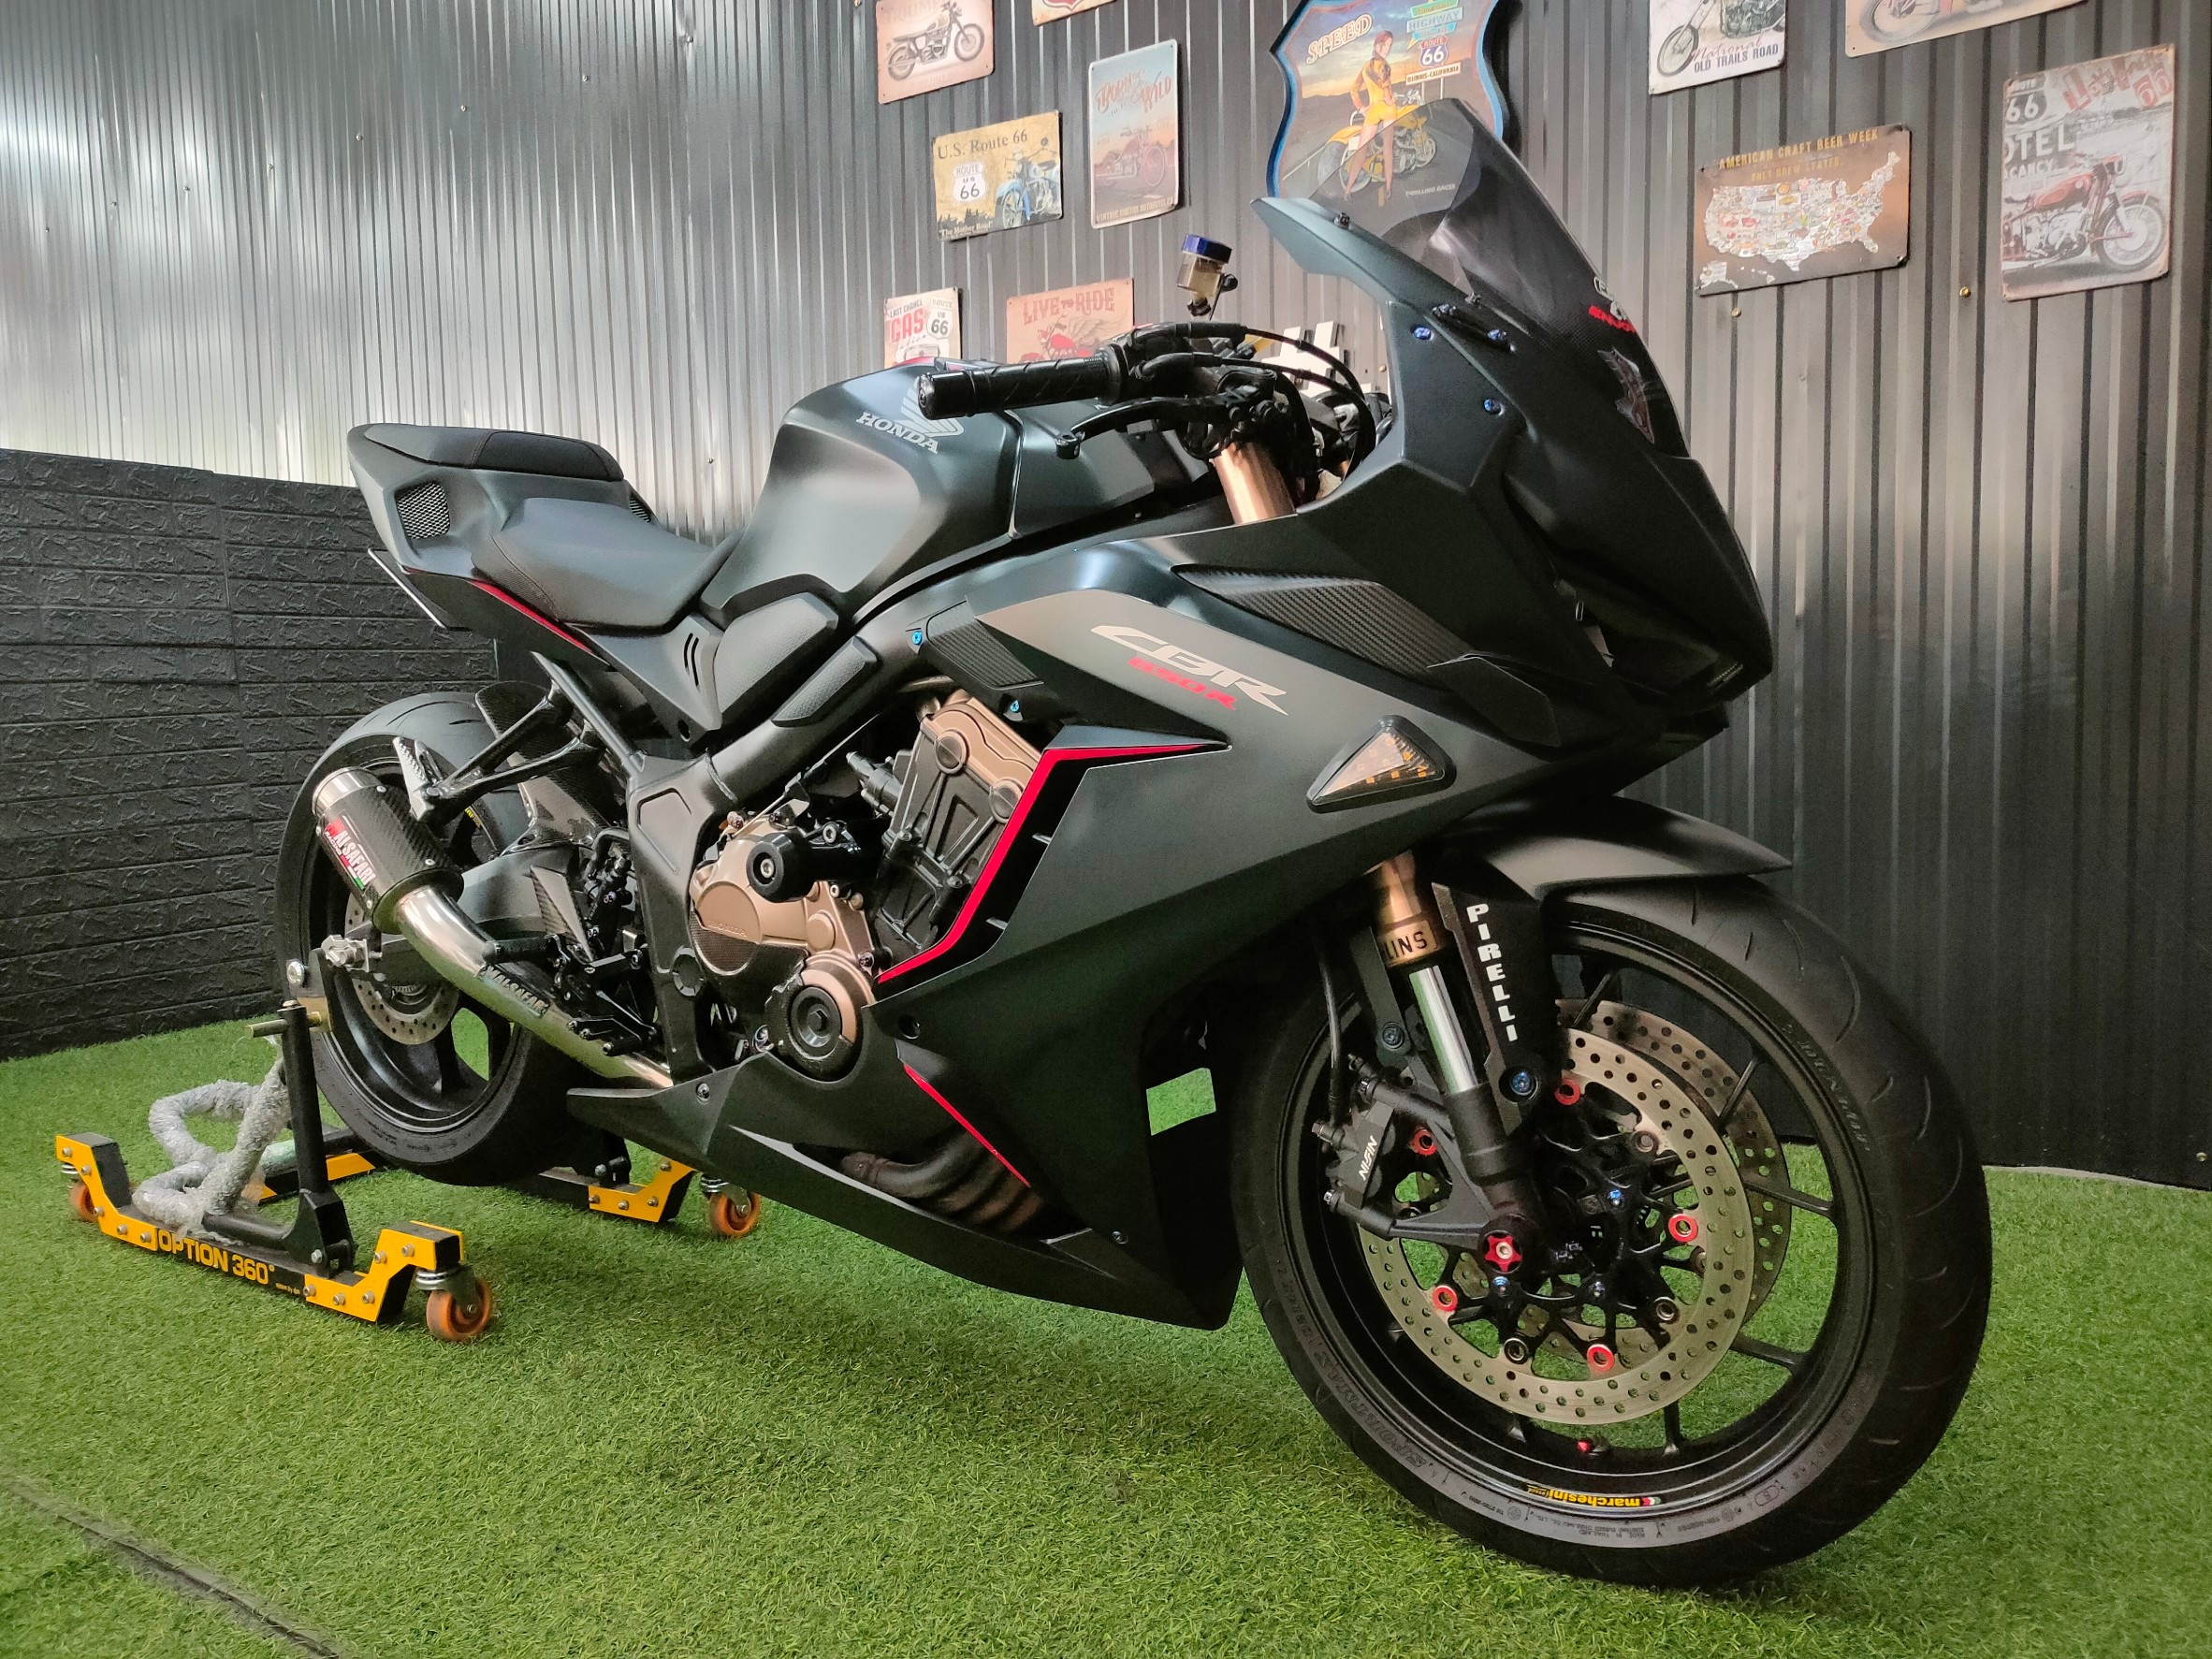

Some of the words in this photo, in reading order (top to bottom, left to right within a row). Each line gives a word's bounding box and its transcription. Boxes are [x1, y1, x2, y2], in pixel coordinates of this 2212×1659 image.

[1409, 10, 1460, 29] HIGHWAY
[1306, 13, 1373, 65] SPEED
[1424, 37, 1444, 48] ROUTE
[1690, 34, 1765, 62] National
[1422, 46, 1445, 65] 66
[1694, 59, 1711, 73] OLD
[1717, 51, 1748, 68] TRAILS
[1753, 43, 1779, 60] ROAD
[2006, 93, 2039, 123] 66
[937, 142, 966, 160] U.S.
[969, 135, 1009, 153] Route
[1012, 128, 1028, 144] 66
[1718, 148, 1774, 170] AMERICAN
[1778, 141, 1812, 158] CRAFT
[1817, 135, 1843, 151] BEER
[1848, 128, 1879, 144] WEEK
[955, 163, 981, 176] ROUTE
[960, 183, 980, 200] 66
[932, 298, 953, 309] ROUTE
[1023, 296, 1060, 326] LIVE
[1075, 286, 1115, 315] RIDE
[891, 308, 924, 343] GAS
[930, 319, 949, 336] 66
[855, 412, 939, 455] HONDA
[1090, 625, 1289, 717] CBR
[1466, 902, 1519, 1043] PIRELLI
[157, 1228, 229, 1274] OPTION
[1549, 1488, 1641, 1508] marchesini
